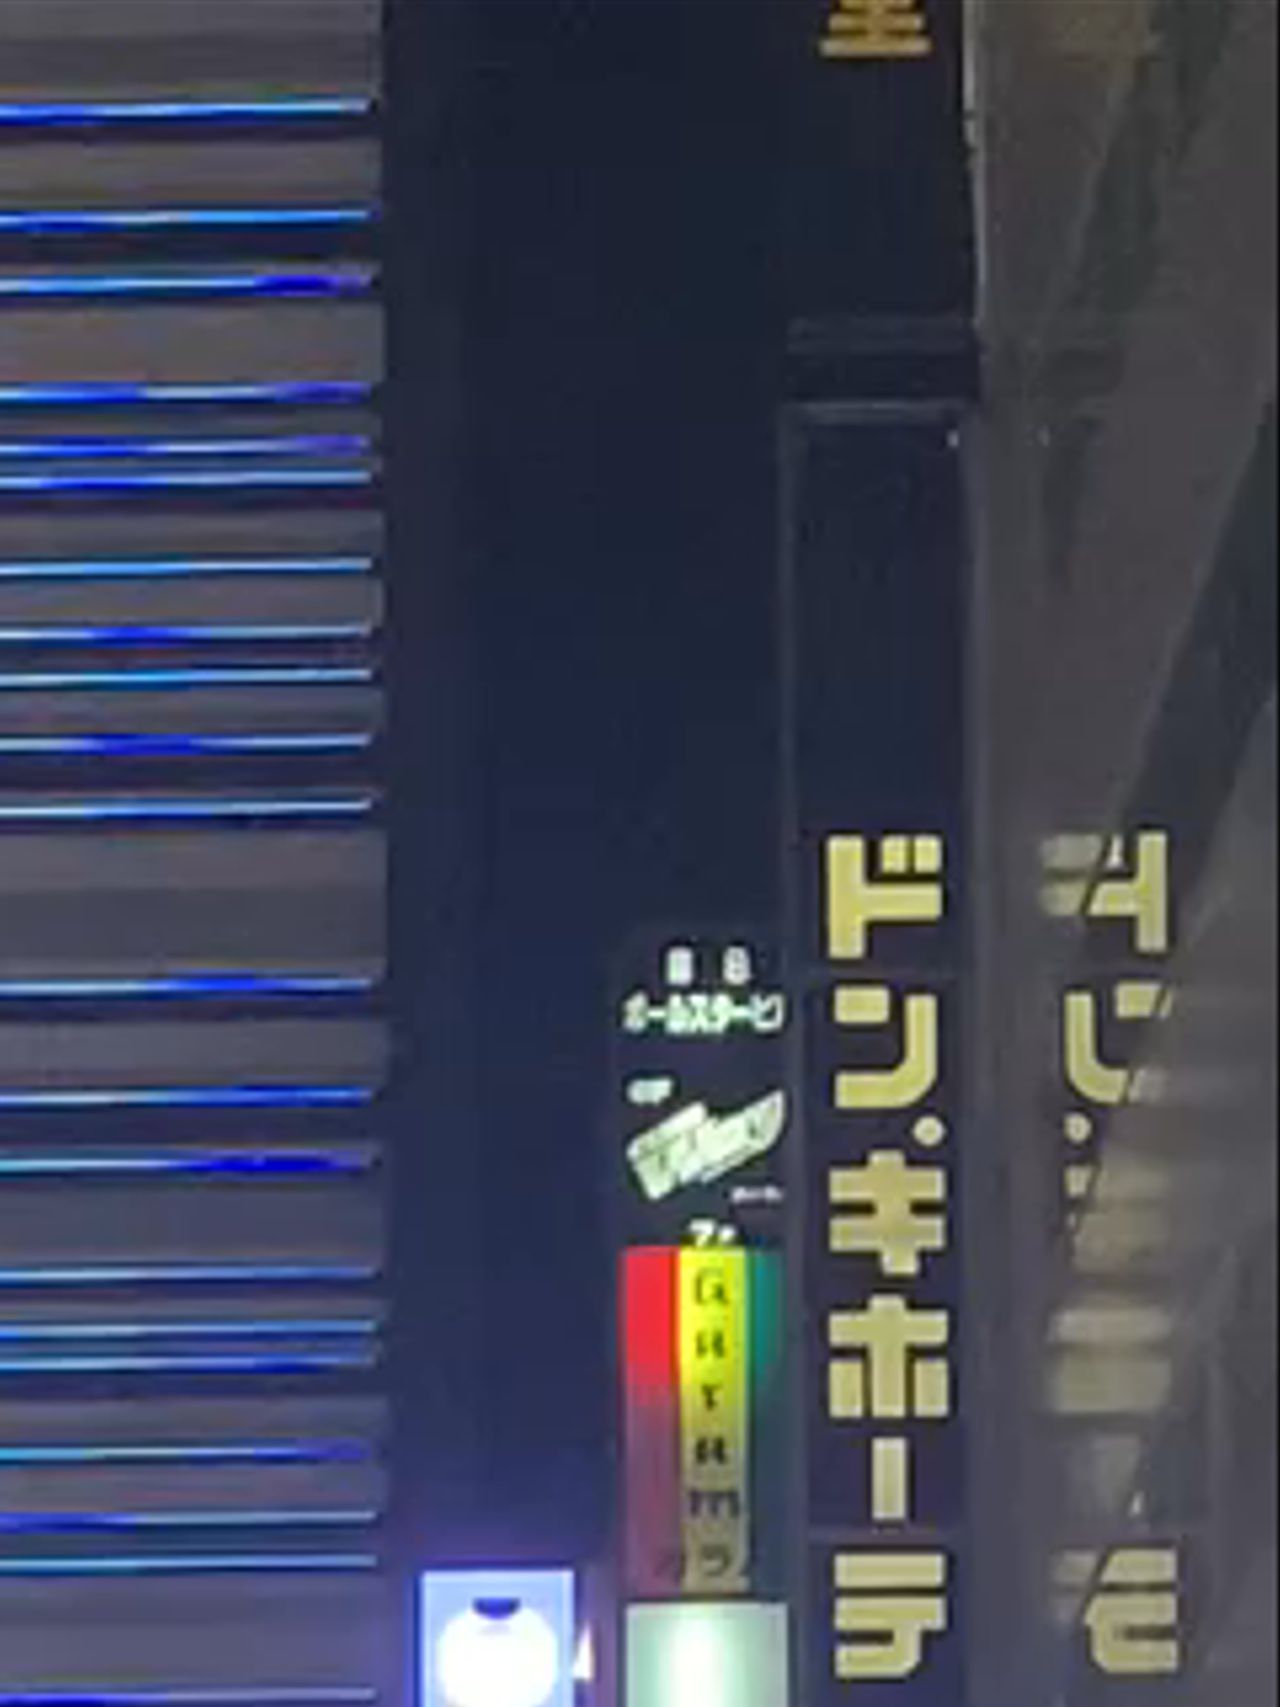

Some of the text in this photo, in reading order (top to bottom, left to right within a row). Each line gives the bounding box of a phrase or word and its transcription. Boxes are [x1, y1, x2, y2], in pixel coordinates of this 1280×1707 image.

[828, 834, 949, 1679] ドン・キホーテ
